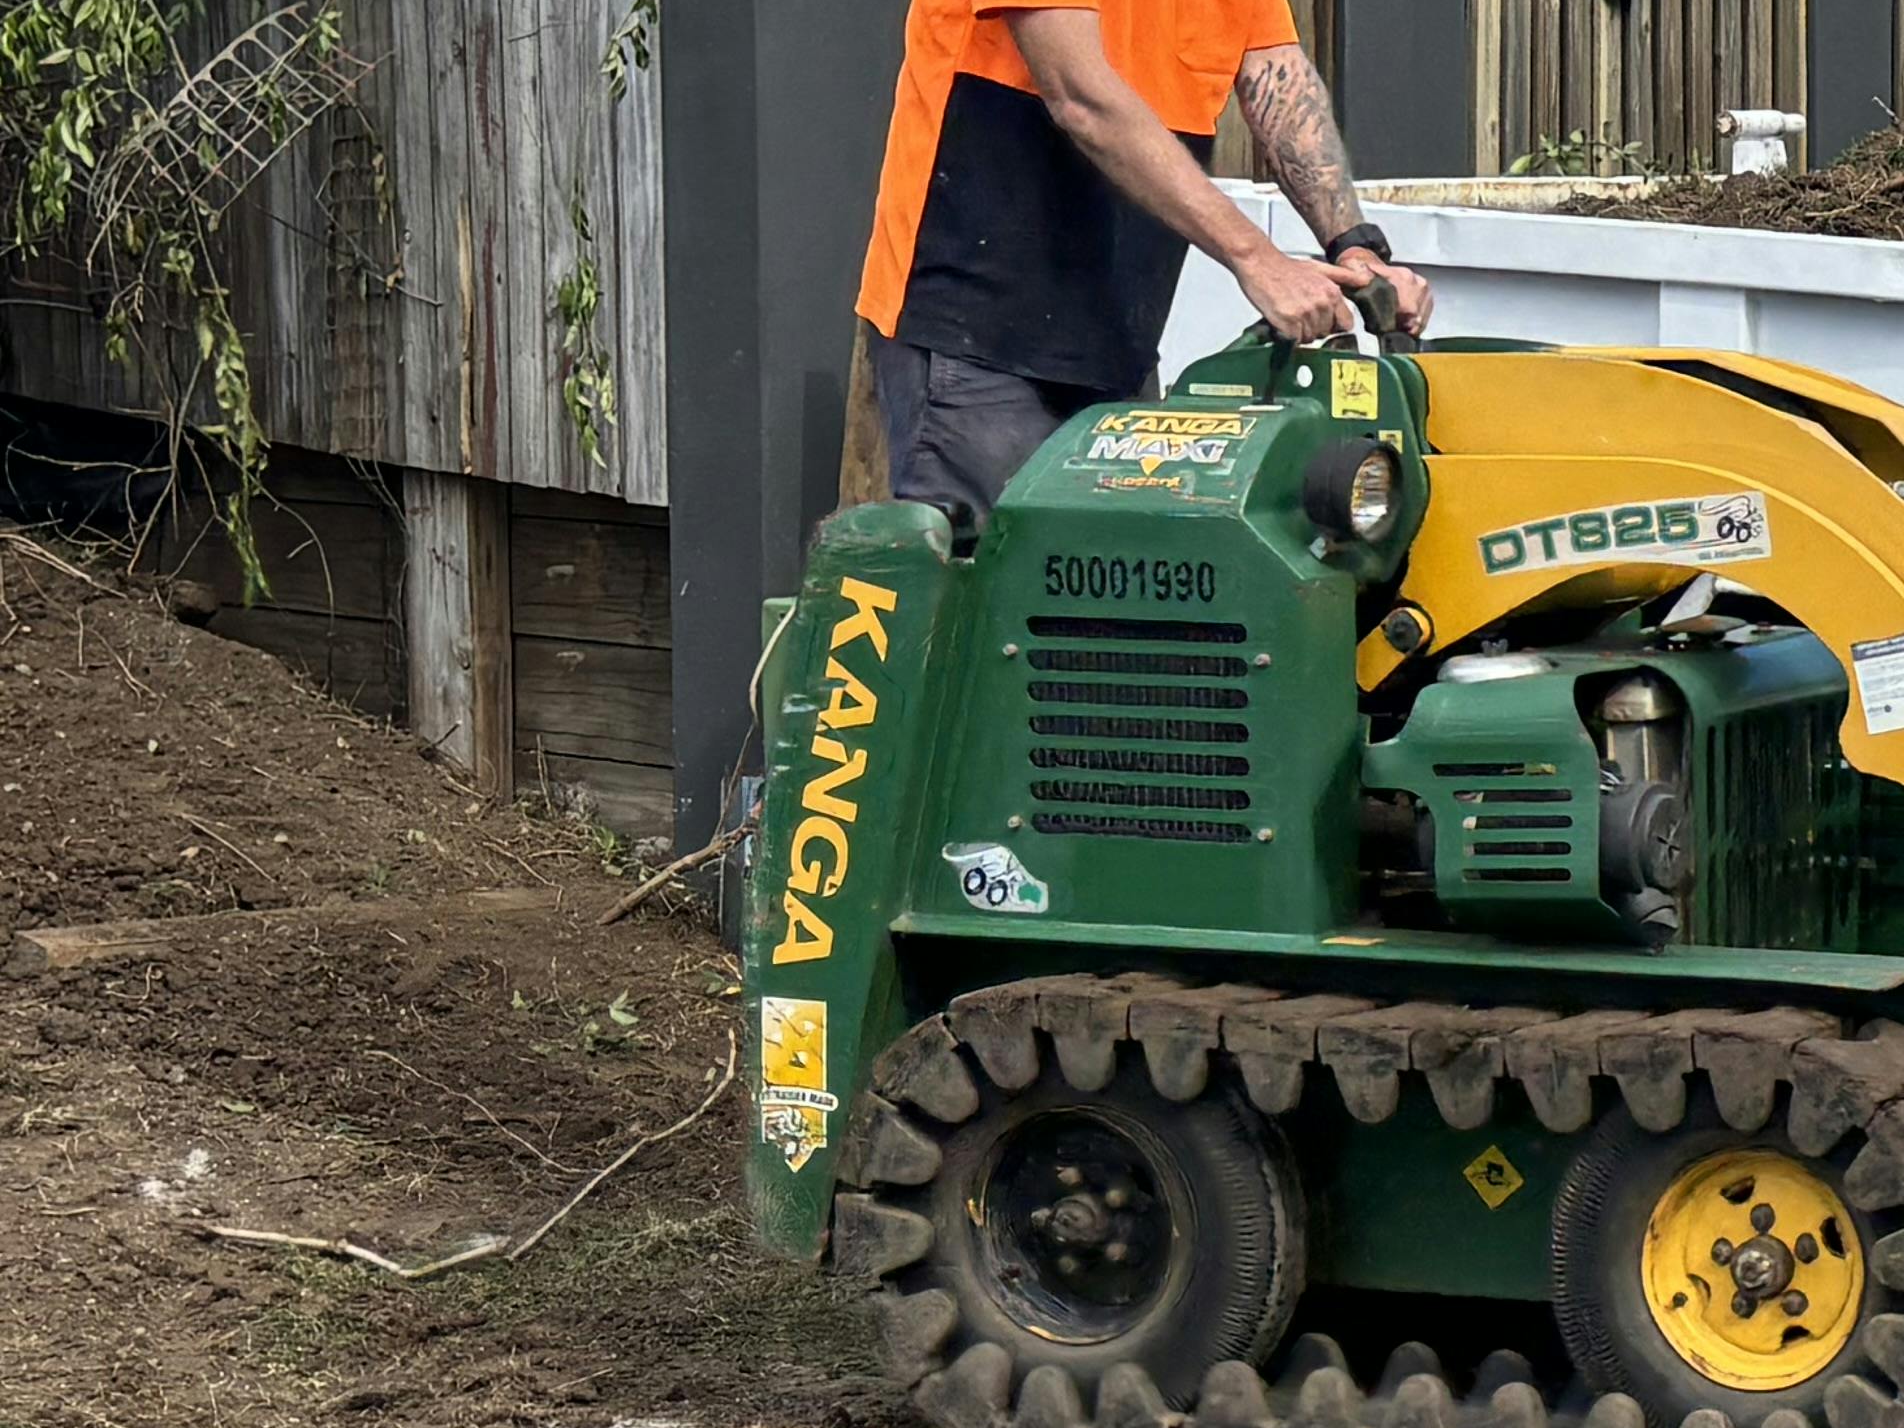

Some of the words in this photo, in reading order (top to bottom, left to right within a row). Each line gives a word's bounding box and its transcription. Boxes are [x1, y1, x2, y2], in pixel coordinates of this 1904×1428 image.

[1100, 414, 1244, 436] KANGA
[1478, 501, 1701, 573] DT825
[772, 576, 898, 965] KANGA
